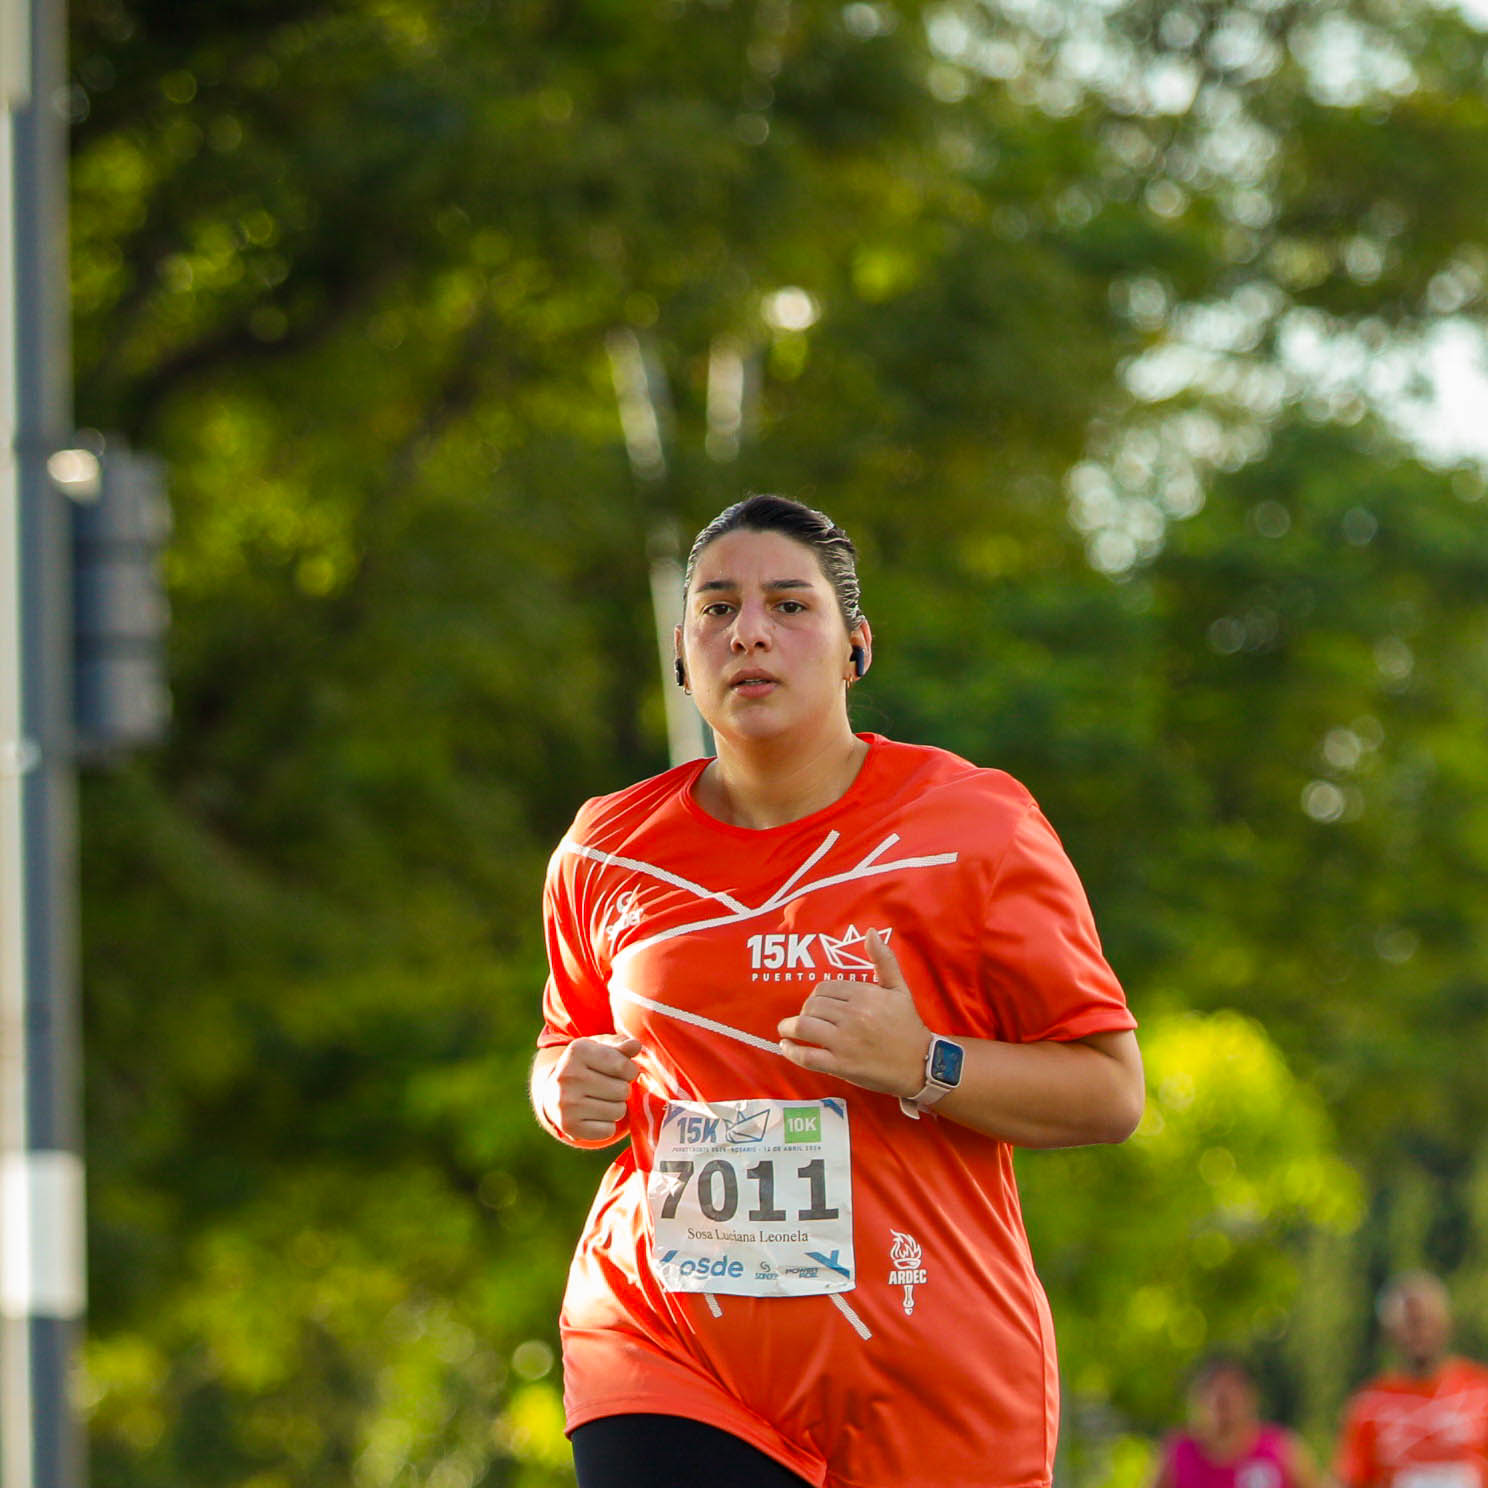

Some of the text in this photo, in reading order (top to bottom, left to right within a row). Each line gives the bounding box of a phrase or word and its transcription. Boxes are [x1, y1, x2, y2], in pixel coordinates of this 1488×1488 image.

[747, 933, 816, 969] 15K
[752, 972, 879, 983] PUERTO NORTE
[677, 1117, 720, 1144] 15K
[787, 1116, 817, 1133] 10K
[659, 1158, 840, 1223] 7011
[687, 1227, 809, 1243] Sosa Luciana Leonela
[679, 1255, 744, 1278] osde
[888, 1269, 927, 1285] ARDEC
